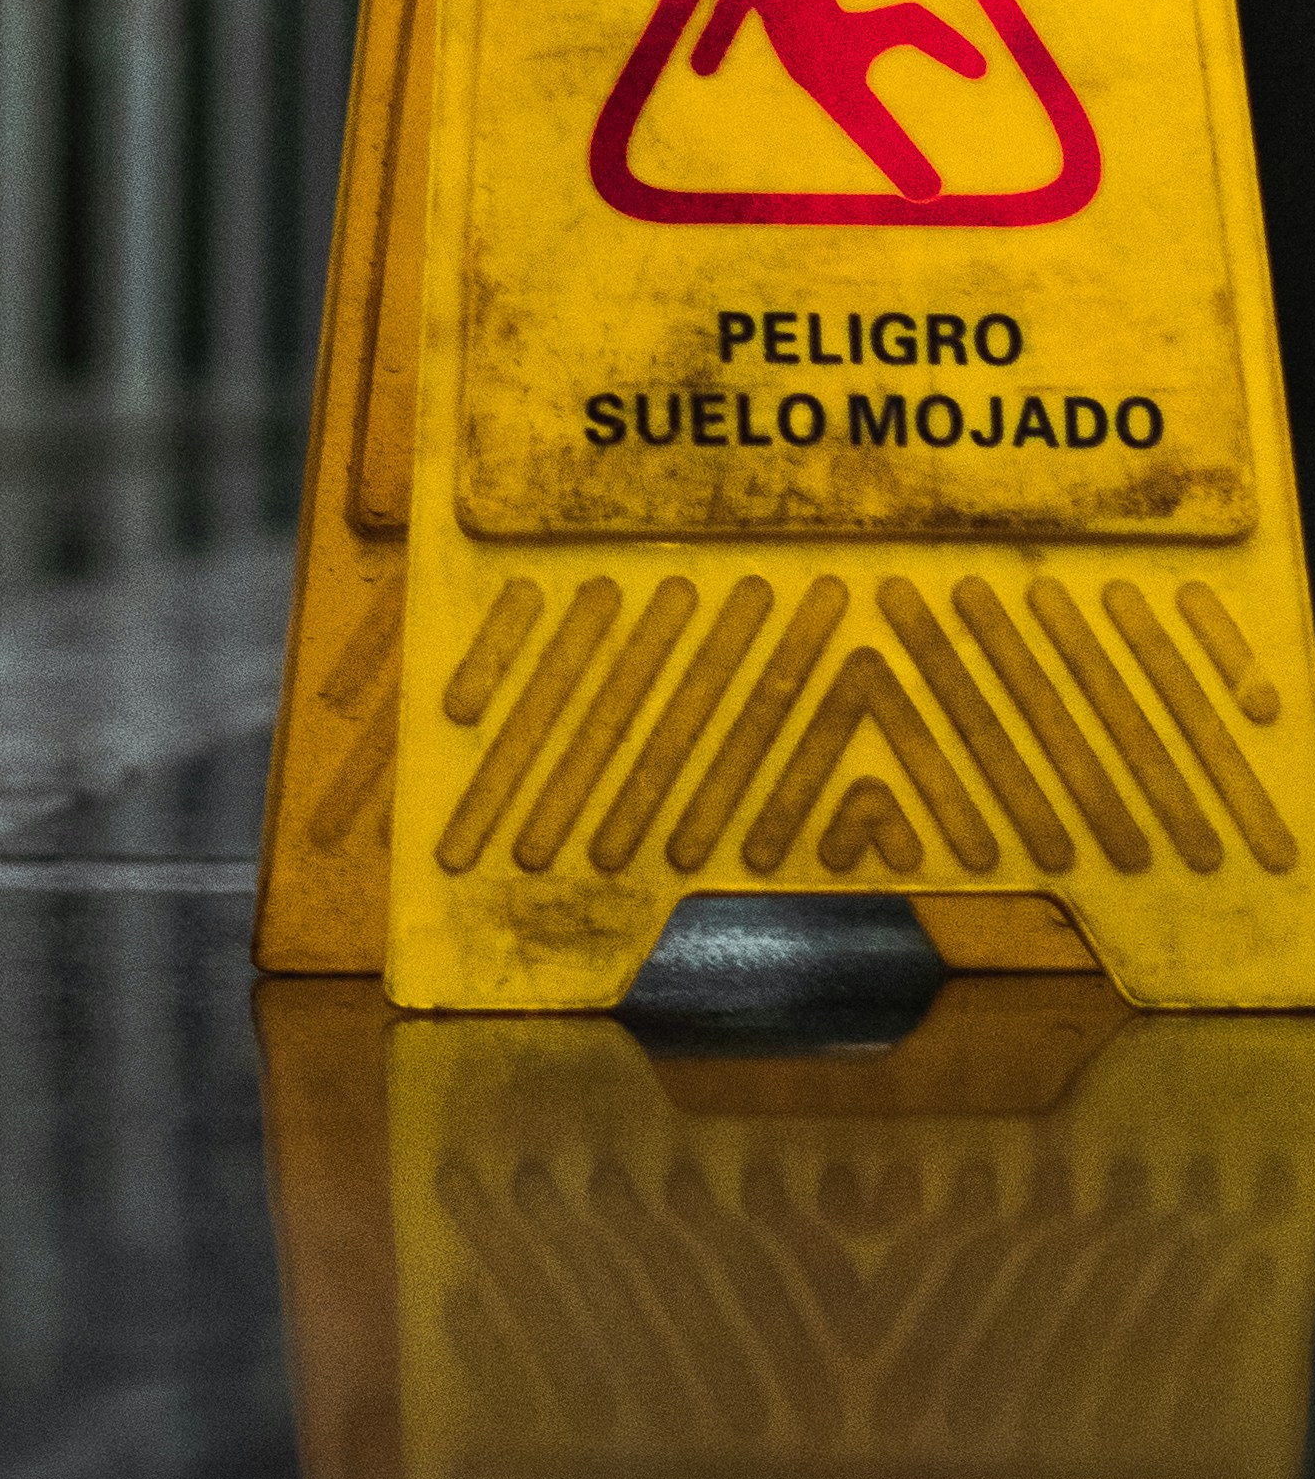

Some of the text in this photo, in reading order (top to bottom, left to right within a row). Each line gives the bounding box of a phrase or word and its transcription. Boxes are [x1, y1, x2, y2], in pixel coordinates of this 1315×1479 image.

[717, 311, 1023, 365] PELIGRO
[585, 393, 1164, 449] SUELO MOJADO
